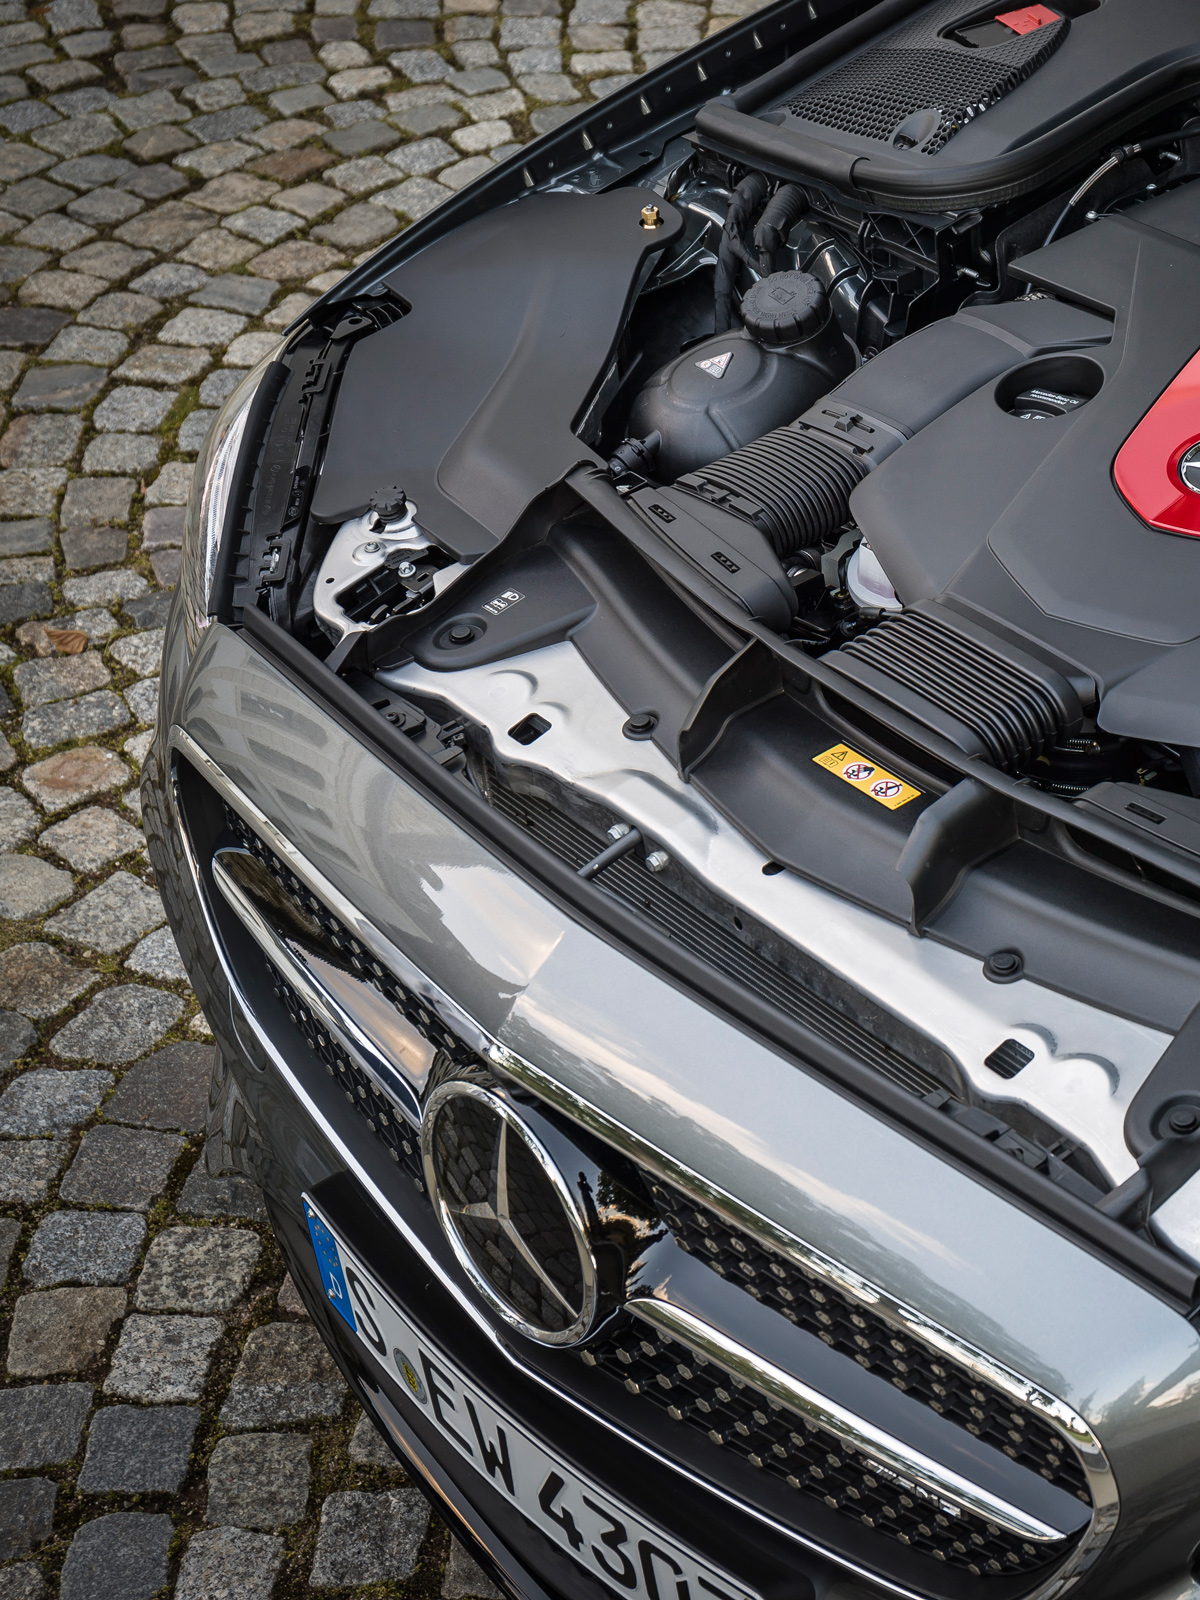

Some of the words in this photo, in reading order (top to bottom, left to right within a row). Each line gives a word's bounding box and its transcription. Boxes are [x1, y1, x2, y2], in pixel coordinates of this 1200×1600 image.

[346, 1266, 388, 1357] S
[418, 1347, 516, 1497] EW
[538, 1470, 740, 1600] 430
